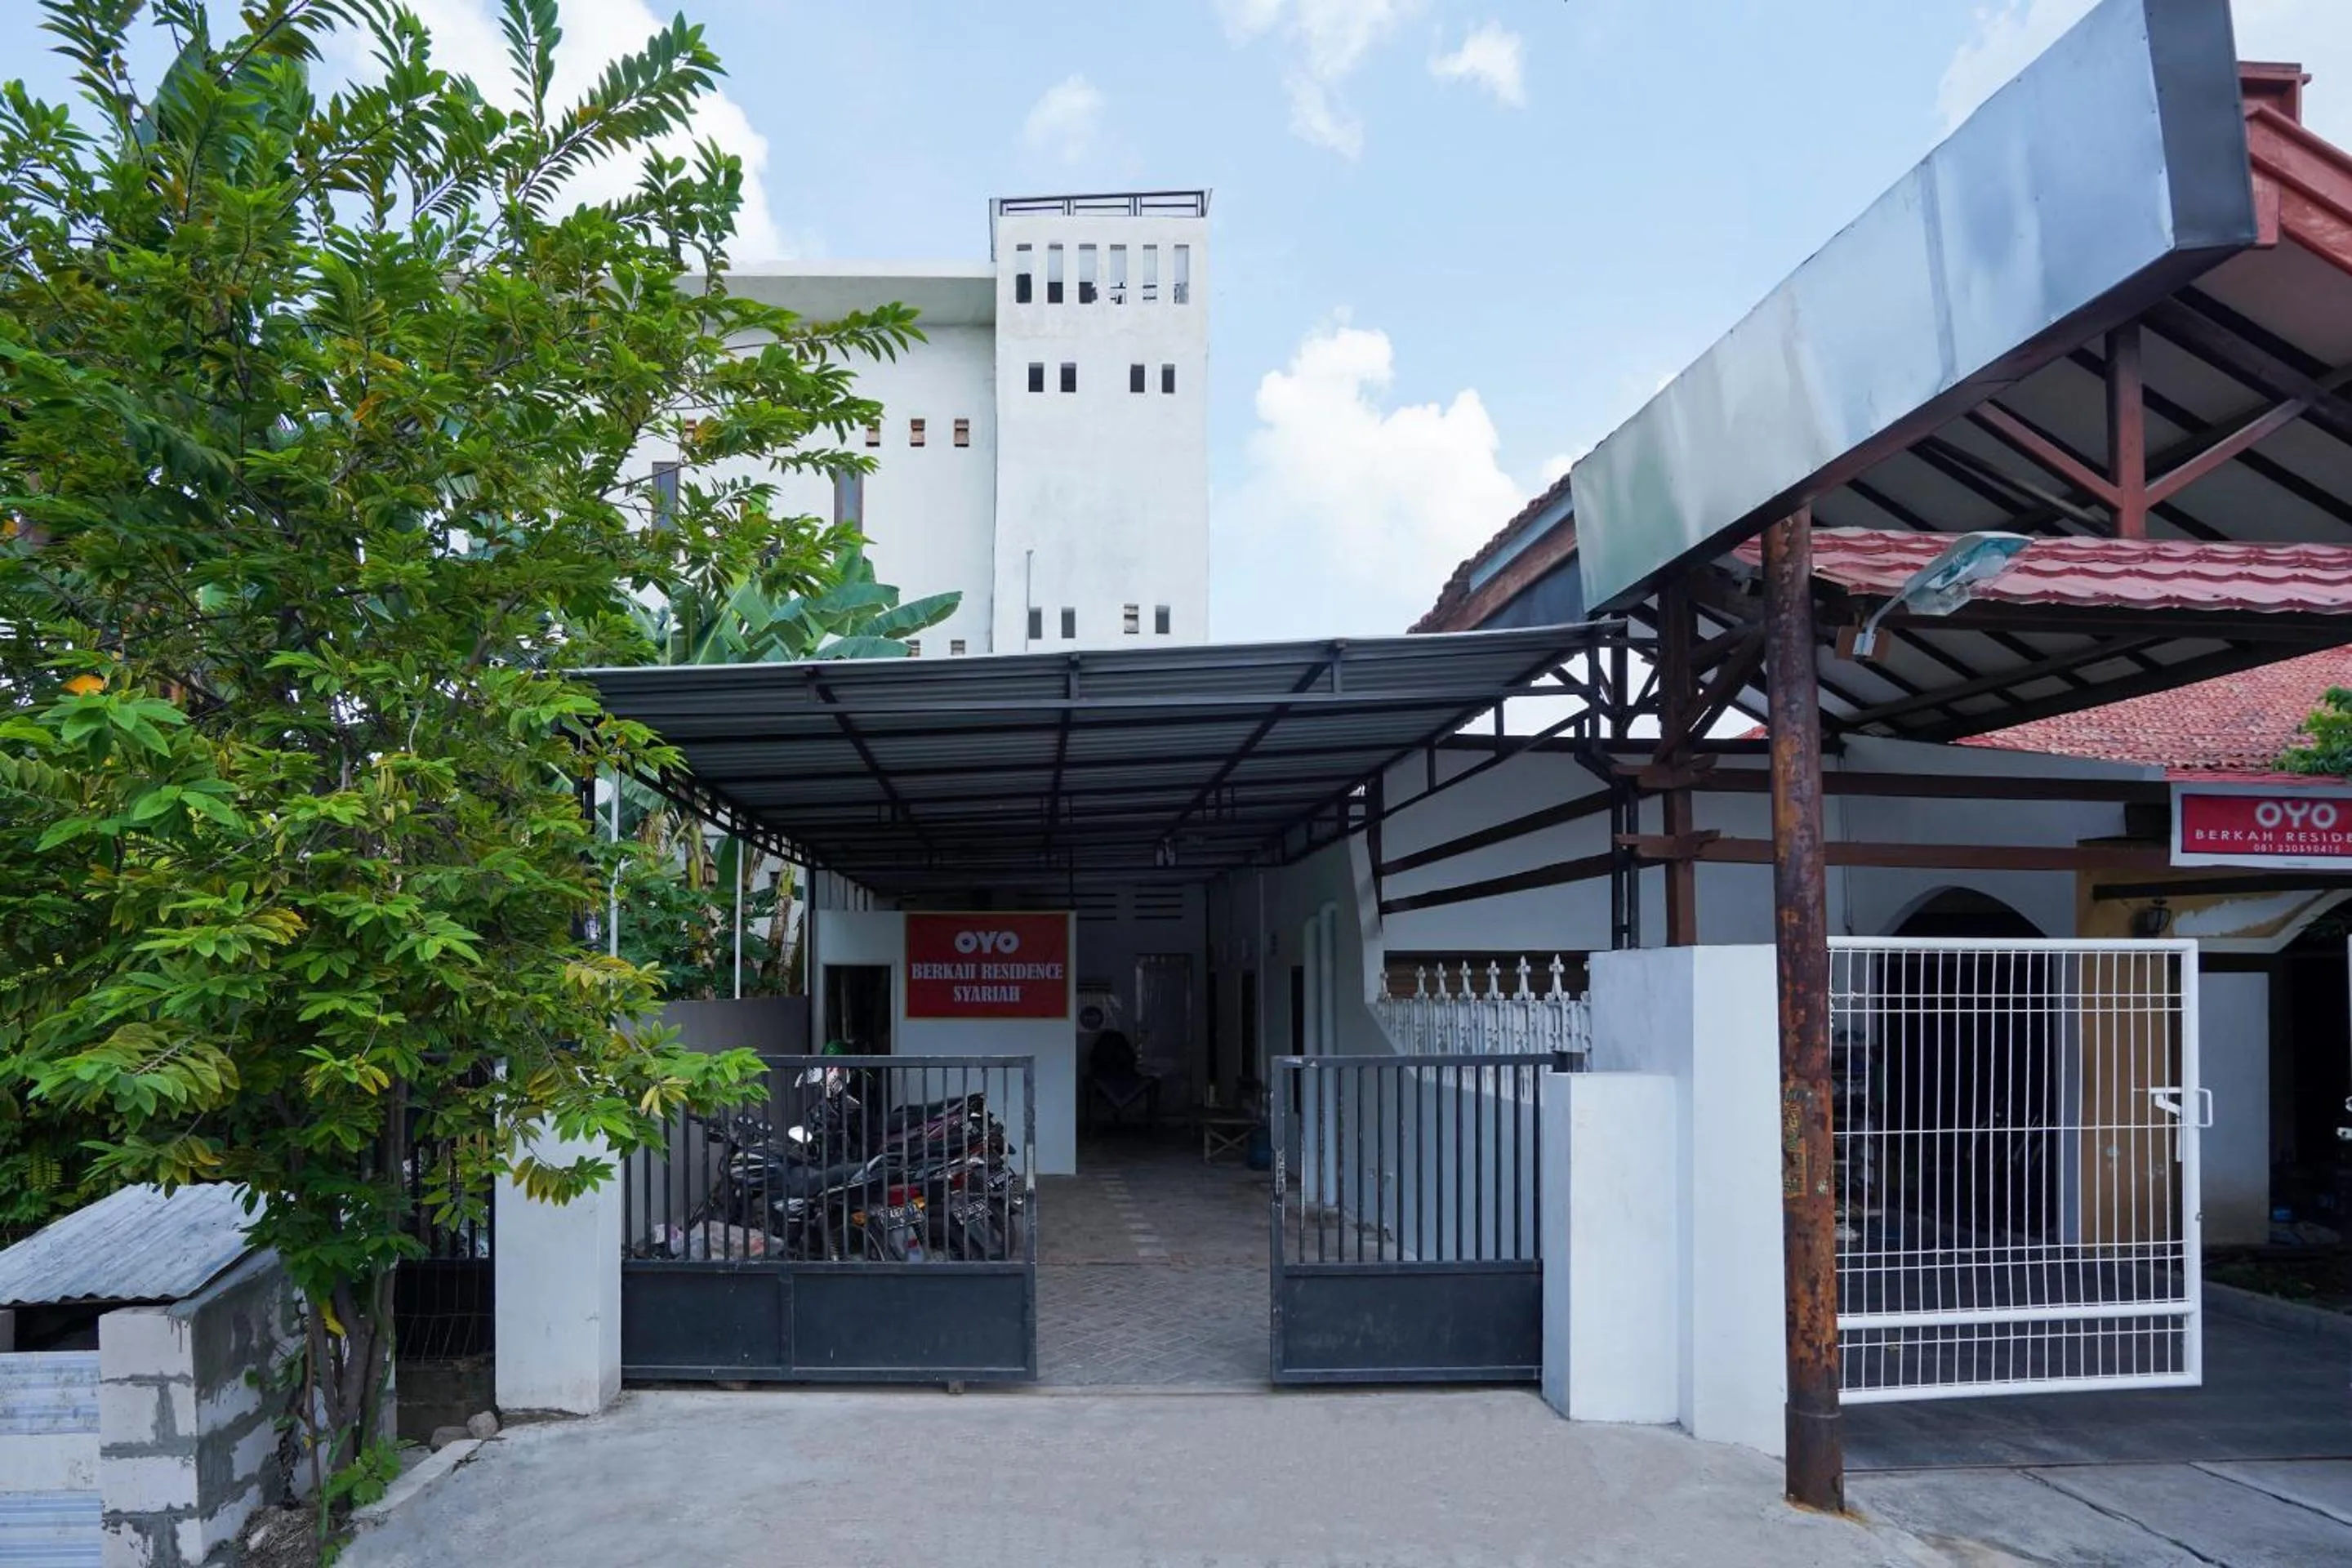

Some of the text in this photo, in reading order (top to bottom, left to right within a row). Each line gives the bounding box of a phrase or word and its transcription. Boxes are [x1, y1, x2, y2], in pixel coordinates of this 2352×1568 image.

[2255, 800, 2337, 830] OYO
[2194, 829, 2274, 841] BERKAH
[954, 931, 1019, 954] OYO
[911, 963, 1063, 980] BERKAH RESIDENCE
[953, 985, 1020, 1003] SYARIAH
